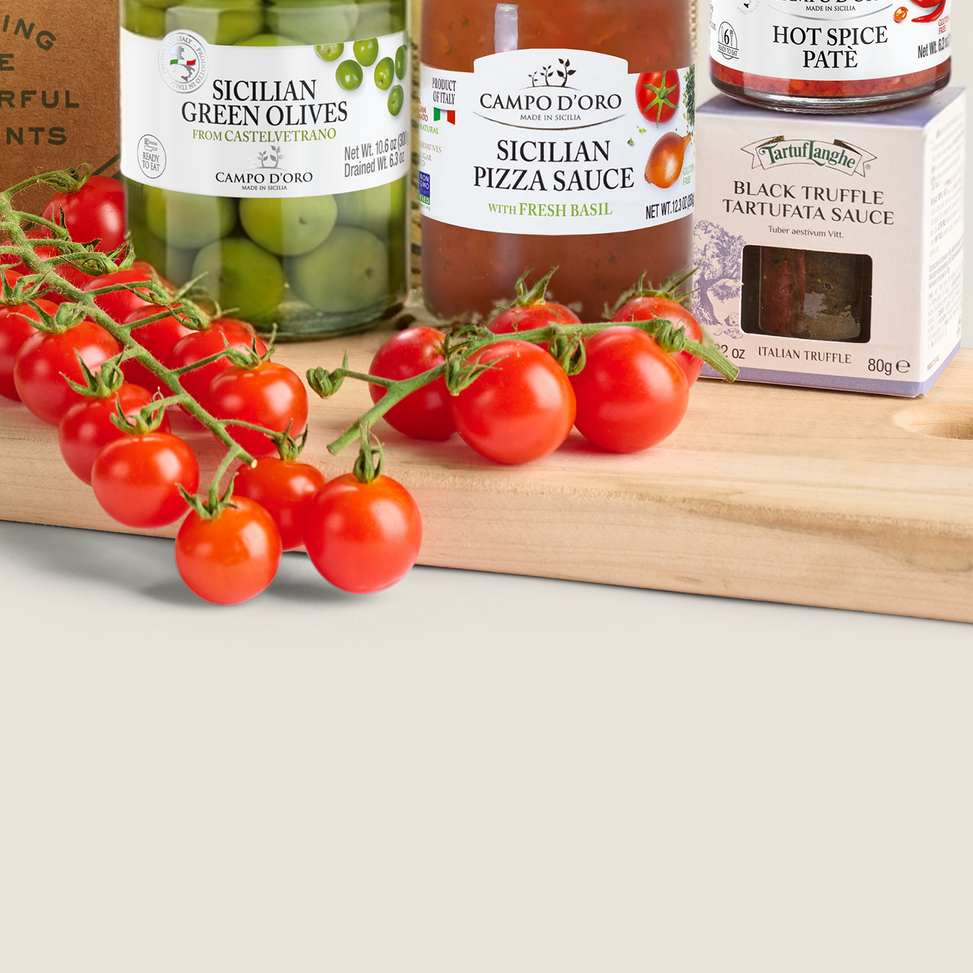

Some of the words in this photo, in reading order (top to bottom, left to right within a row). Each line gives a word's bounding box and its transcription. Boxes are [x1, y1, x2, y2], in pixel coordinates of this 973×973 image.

[723, 28, 730, 45] 6
[772, 25, 822, 46] HOT
[826, 25, 889, 47] SPICE
[802, 46, 859, 69] PATÈ
[917, 43, 928, 59] Net
[212, 79, 317, 101] SICILIAN
[432, 77, 457, 92] PRODUCT
[432, 90, 439, 102] OF
[440, 91, 456, 105] ITALY
[479, 93, 552, 111] CAMPO
[557, 93, 623, 111] D'ORO
[181, 101, 259, 126] GREEN
[265, 100, 349, 127] OLIVES
[192, 129, 223, 142] FROM
[224, 127, 337, 143] CASTELVETRANO
[142, 152, 160, 163] READY
[344, 145, 359, 161] Net
[360, 142, 374, 158] Wt.
[375, 138, 389, 155] 10.6
[496, 139, 611, 163] SICILIAN
[142, 161, 150, 170] TO
[150, 162, 160, 172] EAT
[344, 158, 376, 178] Drained
[377, 155, 388, 171] Wt.
[389, 152, 399, 168] 6.3
[215, 172, 265, 184] CAMPO
[269, 171, 313, 184] D'ORO
[473, 165, 548, 192] PIZZA
[552, 166, 635, 192] SAUCE
[733, 180, 796, 199] BLACK
[801, 185, 884, 206] TRUFFLE
[487, 203, 517, 216] WITH
[518, 202, 566, 218] FRESH
[570, 202, 613, 218] BASIL
[645, 203, 660, 220] NET
[722, 198, 826, 221] TARTUFATA
[831, 210, 895, 226] SAUCE
[767, 225, 790, 235] Tuber
[791, 228, 826, 237] aestivum
[827, 229, 844, 239] Vitt.
[732, 348, 746, 360] oz
[758, 346, 801, 360] ITALIAN
[803, 350, 852, 364] TRUFFLE
[868, 358, 893, 375] 80g
